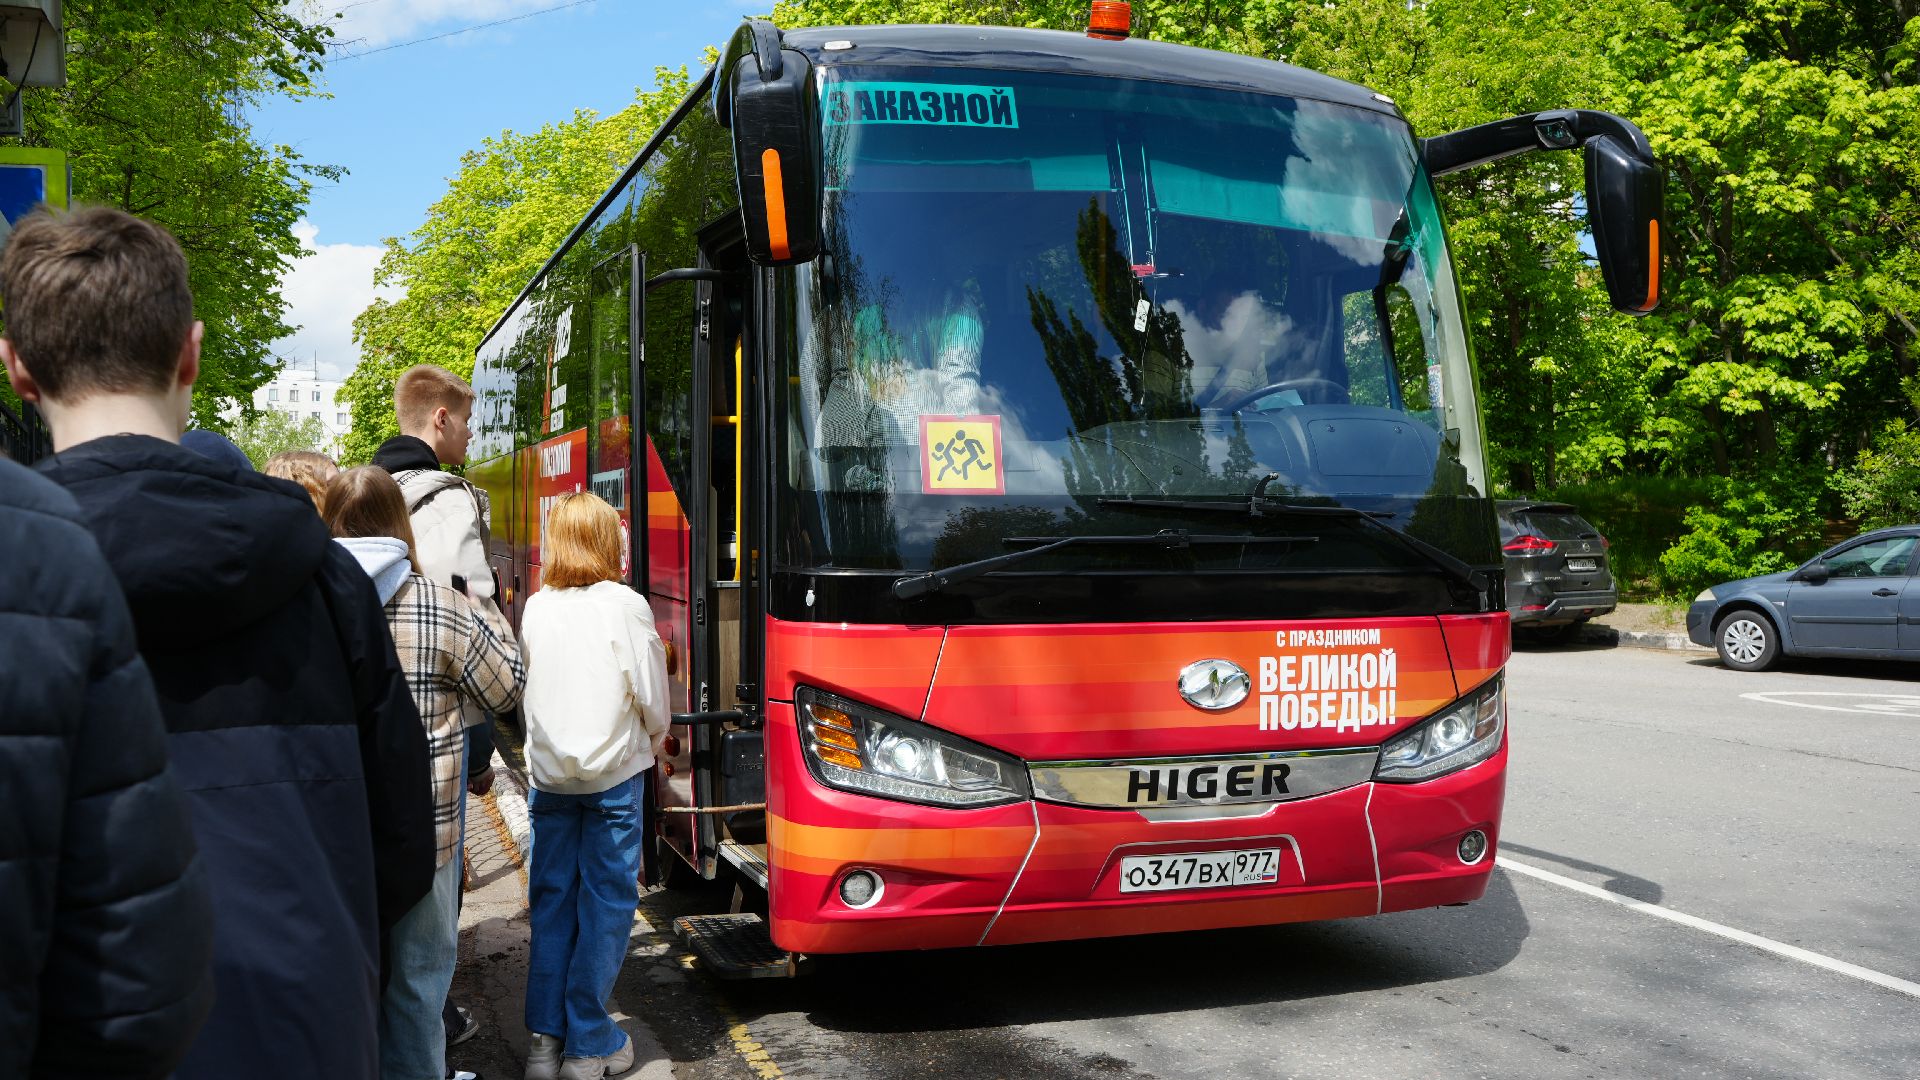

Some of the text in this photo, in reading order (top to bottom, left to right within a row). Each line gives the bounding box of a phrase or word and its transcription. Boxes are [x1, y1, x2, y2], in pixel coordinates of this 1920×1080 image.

[831, 89, 1013, 126] ЗАКАЗНОЙ
[1276, 629, 1381, 649] С ПРАЗДНИКОМ
[1259, 648, 1397, 693] ВЕЛИКОЙ
[1259, 690, 1396, 733] ПОБЕДЫ!
[1127, 763, 1291, 803] HIGER
[1236, 852, 1273, 873] 977
[1243, 873, 1262, 881] RUS
